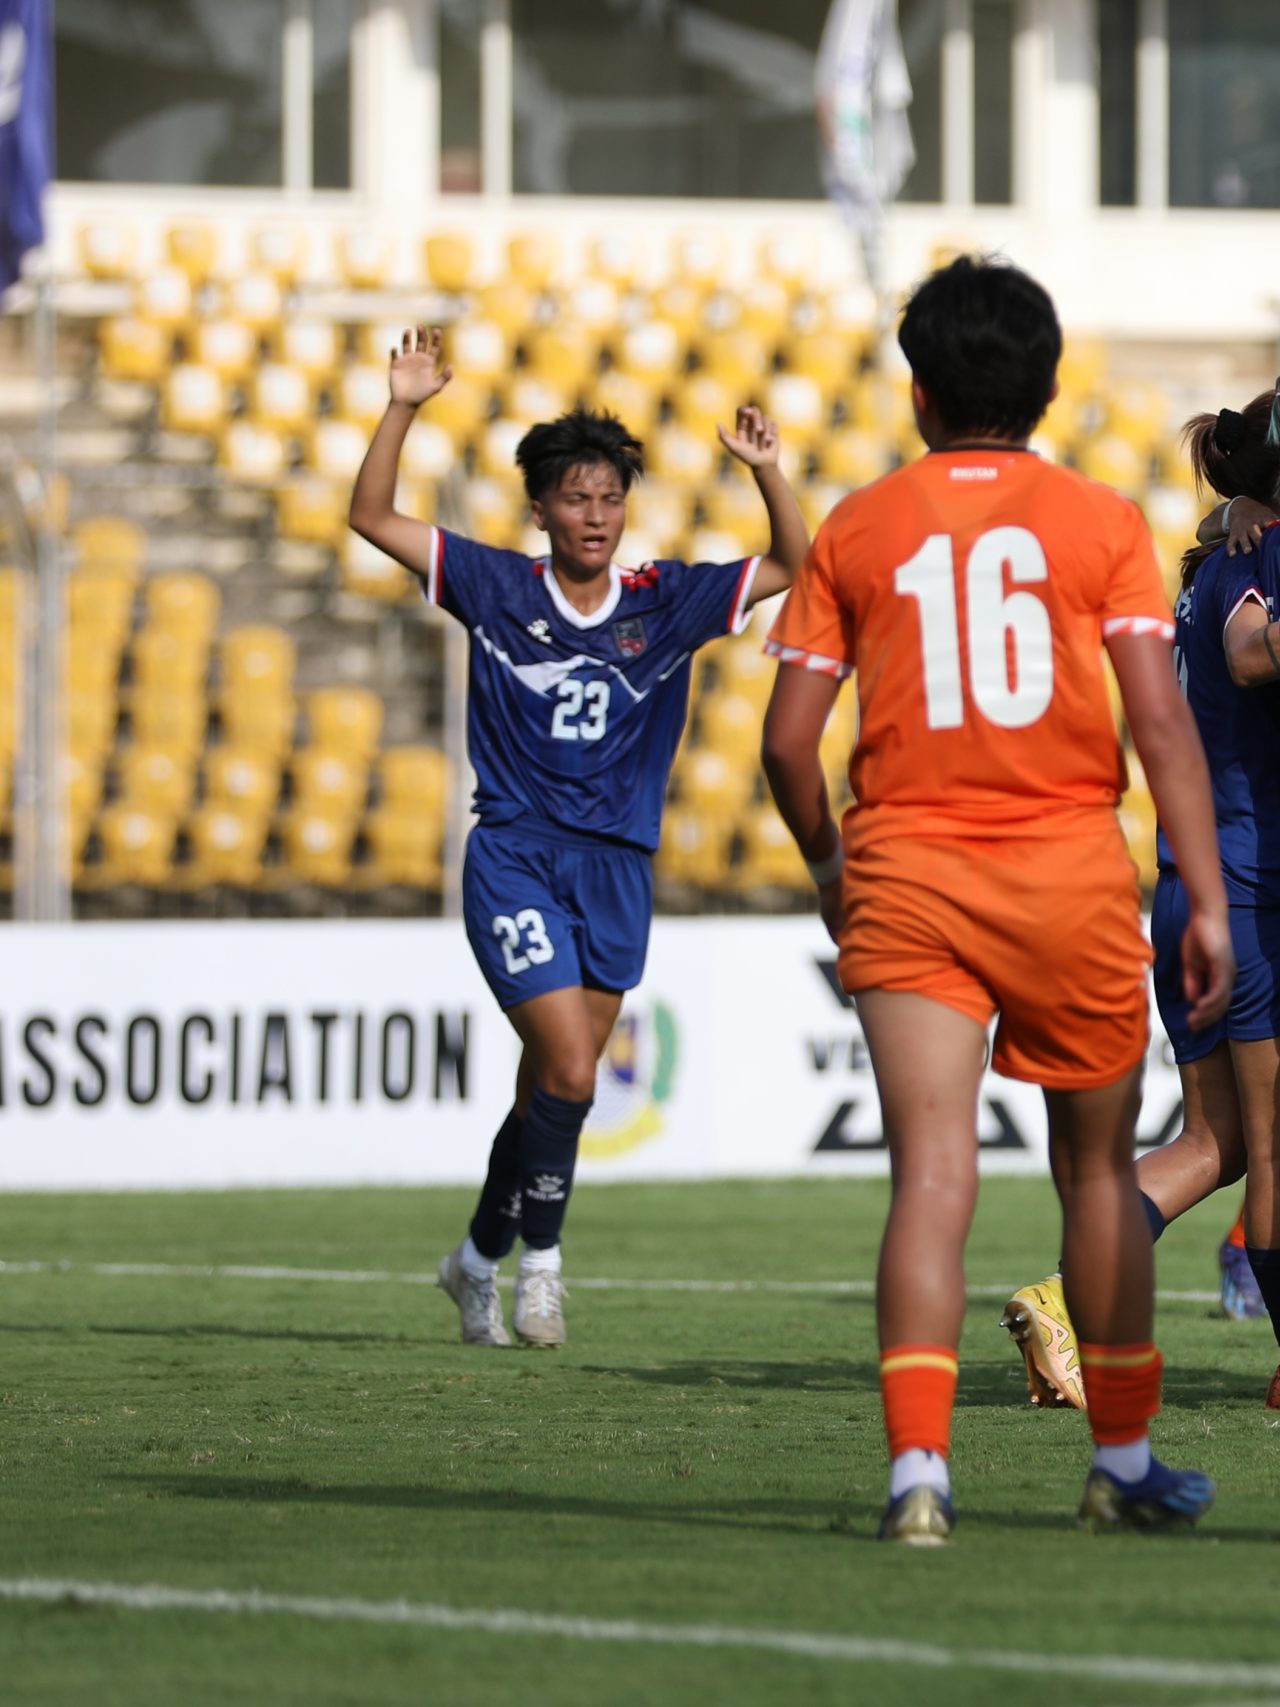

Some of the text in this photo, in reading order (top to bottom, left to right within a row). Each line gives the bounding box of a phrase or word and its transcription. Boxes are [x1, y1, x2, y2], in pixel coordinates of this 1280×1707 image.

[895, 525, 1054, 730] 16
[551, 678, 611, 740] 23
[492, 908, 554, 975] 23
